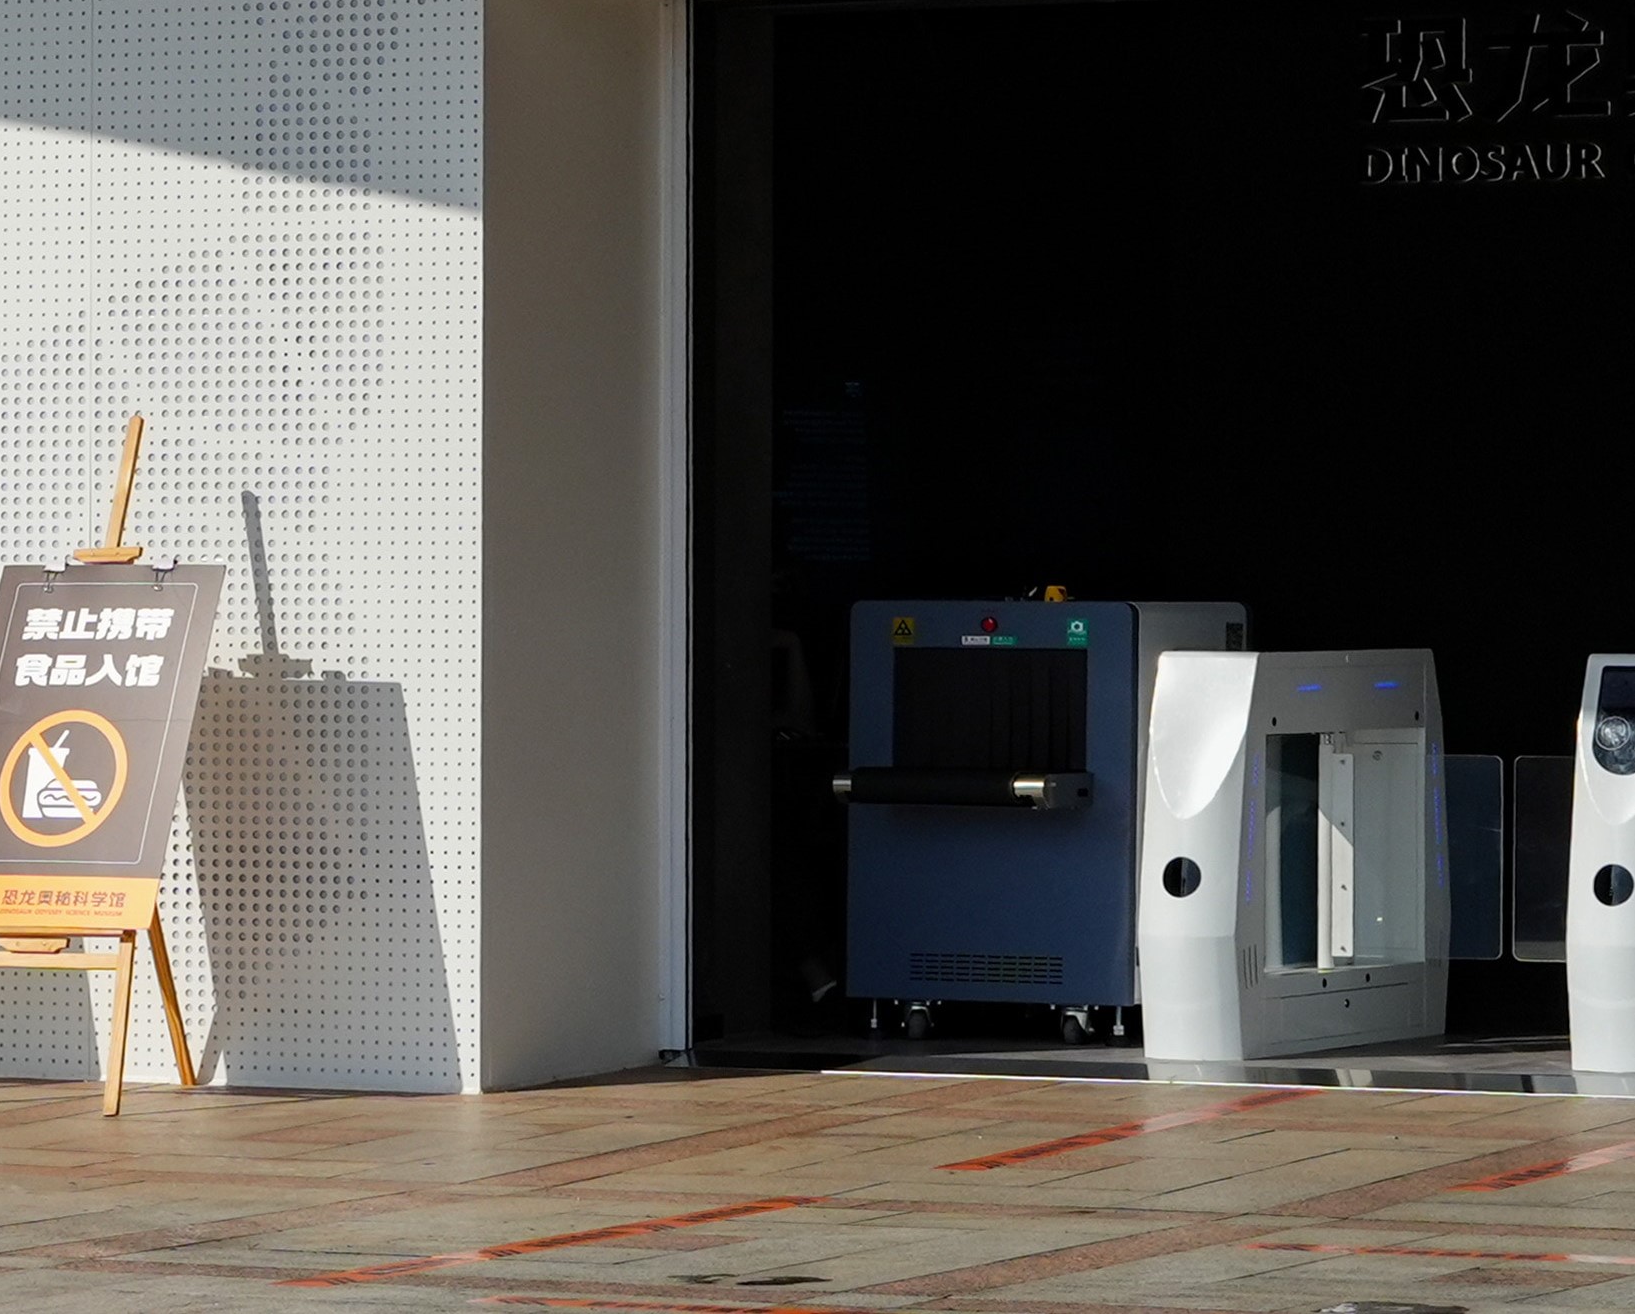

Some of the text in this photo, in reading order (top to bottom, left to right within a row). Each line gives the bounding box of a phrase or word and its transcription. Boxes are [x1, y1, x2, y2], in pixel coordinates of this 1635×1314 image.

[1360, 9, 1635, 125] 恐龙
[1360, 140, 1606, 184] DINOSAUR
[22, 607, 175, 640] 禁止携带
[15, 653, 164, 687] 食品入馆
[1, 888, 126, 908] 恐龙奥秘科学馆
